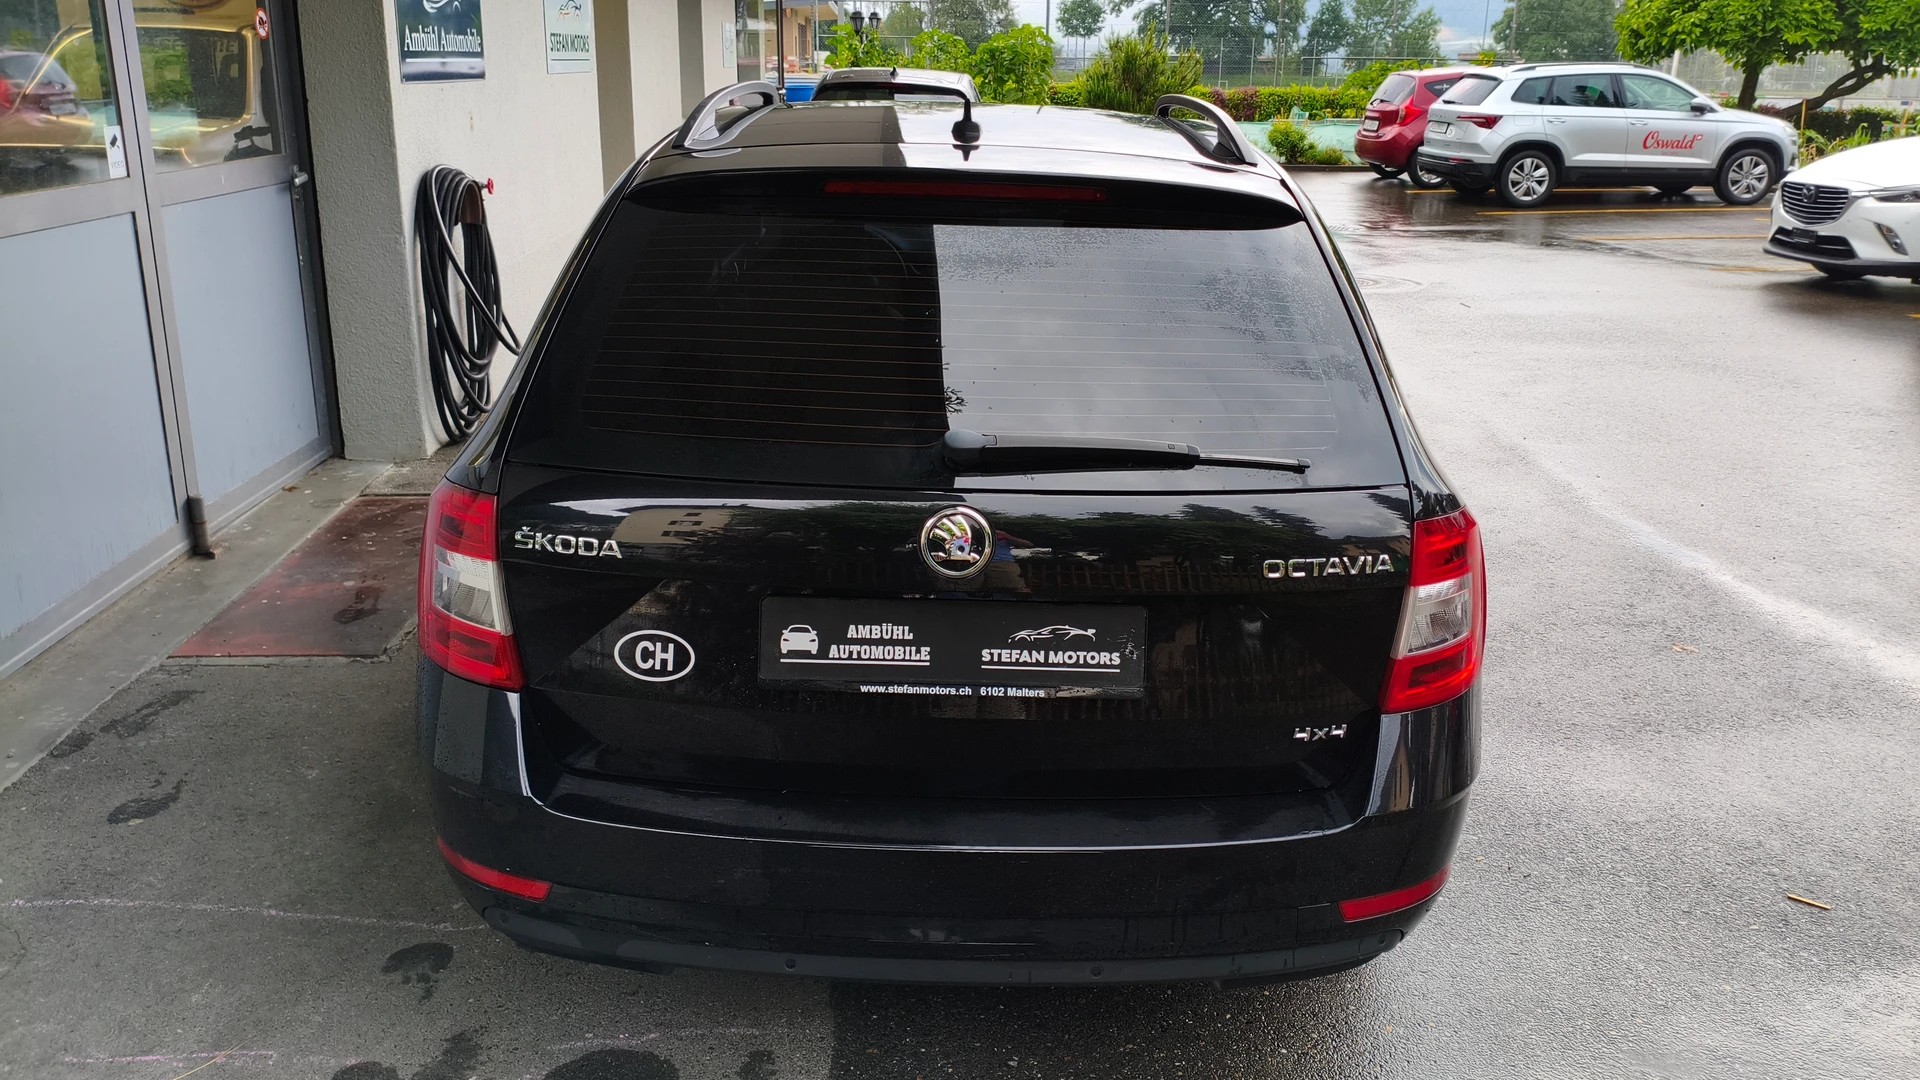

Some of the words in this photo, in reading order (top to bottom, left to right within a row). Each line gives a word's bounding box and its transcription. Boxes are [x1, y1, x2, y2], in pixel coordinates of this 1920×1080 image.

[405, 25, 439, 51] Ambühl
[440, 28, 481, 52] Automobile
[550, 33, 571, 52] STEFAN
[570, 34, 589, 52] MOTORS
[1642, 130, 1696, 150] Oswald
[514, 526, 623, 559] ŠKODA
[1263, 554, 1395, 579] OCTAVIA
[847, 623, 913, 640] AMBÜHL
[635, 640, 675, 671] CH
[828, 644, 931, 661] AUTOMOBILE
[981, 649, 1045, 663] STEFAN
[1049, 650, 1121, 666] MOTORS
[860, 684, 972, 695] www.stefanmotors.ch
[980, 686, 1004, 696] 6102
[1007, 687, 1045, 697] Malters
[1293, 724, 1347, 741] 4x4
